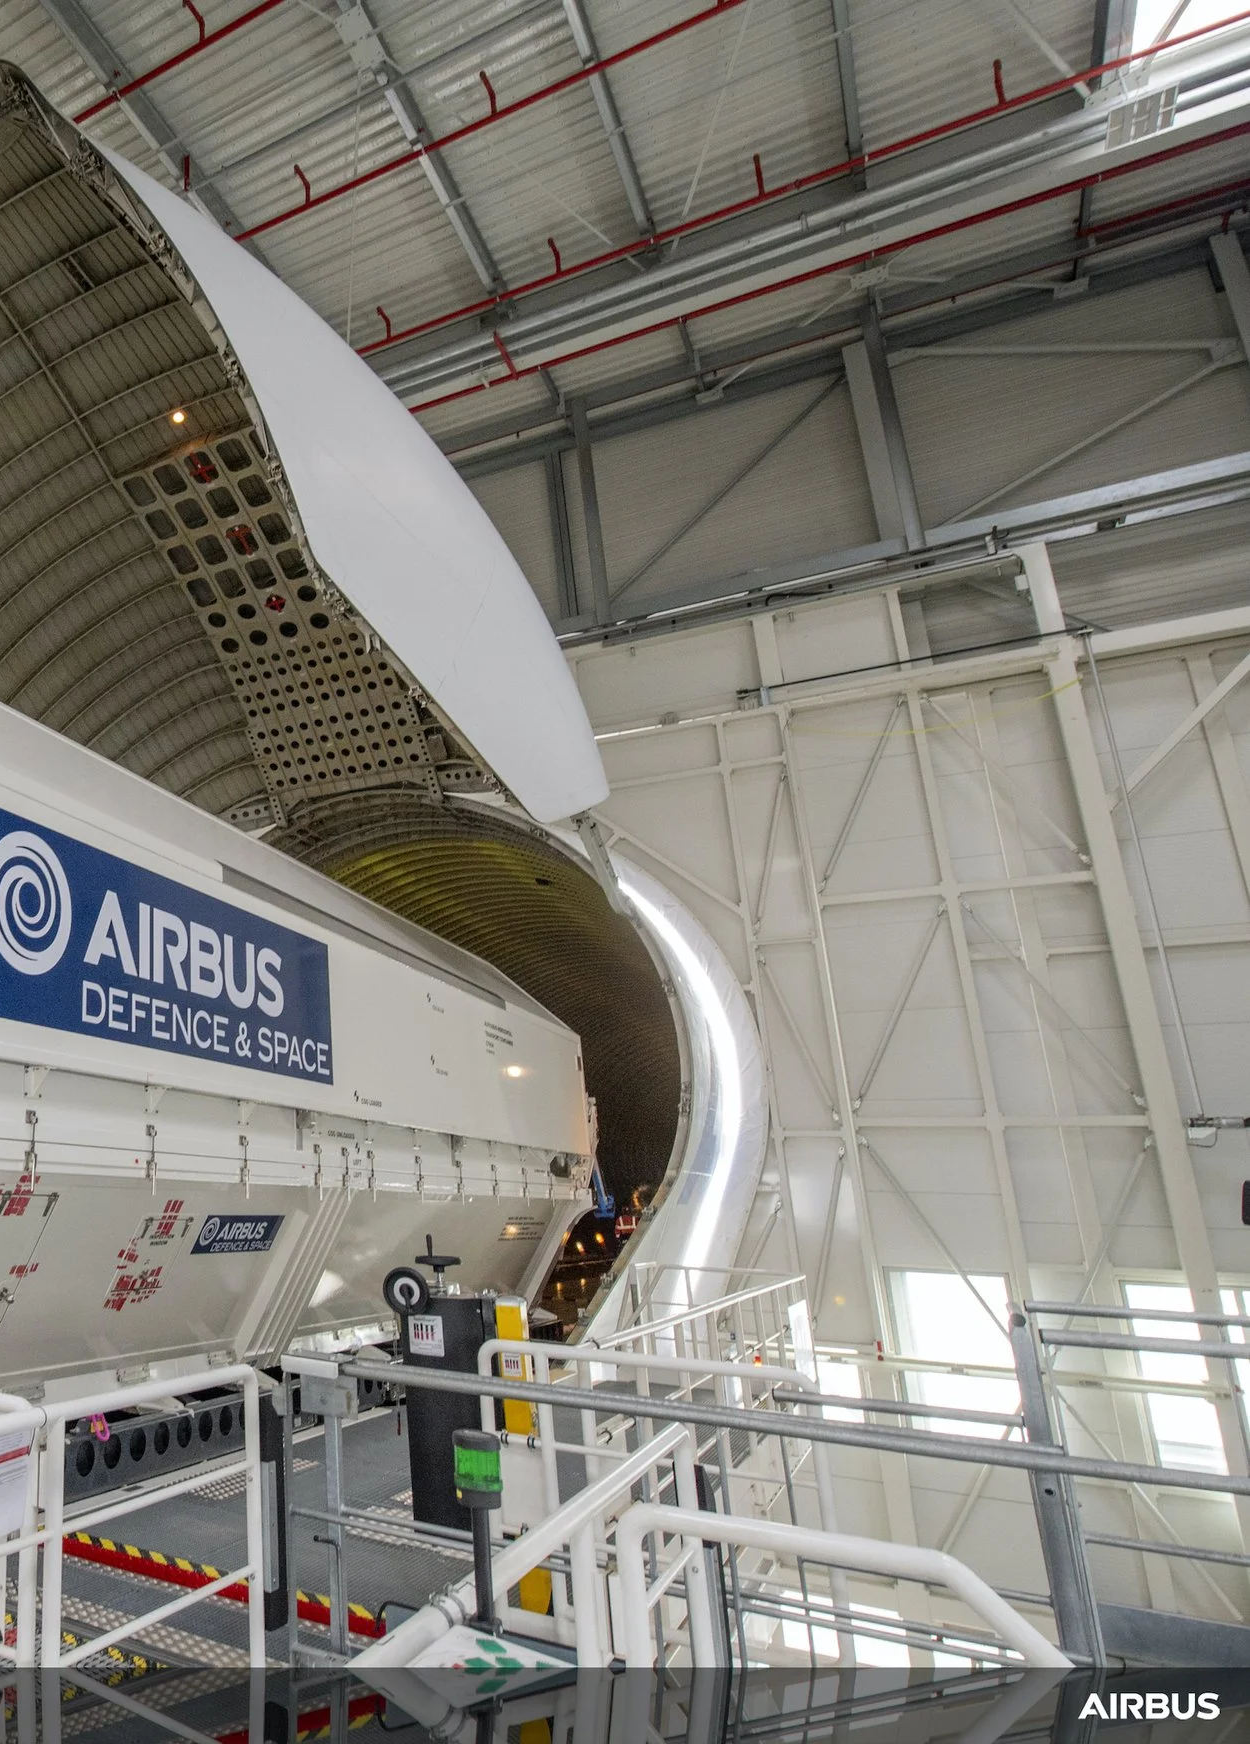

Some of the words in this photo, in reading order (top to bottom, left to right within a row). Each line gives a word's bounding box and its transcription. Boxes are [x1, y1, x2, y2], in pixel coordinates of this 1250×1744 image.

[83, 889, 284, 1018] AIRBUS
[81, 979, 230, 1054] DEFENCE
[234, 1021, 252, 1058] &
[257, 1026, 331, 1076] SPACE
[210, 1241, 245, 1252] DEFENCE
[249, 1240, 272, 1250] SPACE
[216, 1222, 268, 1240] AIRBUS
